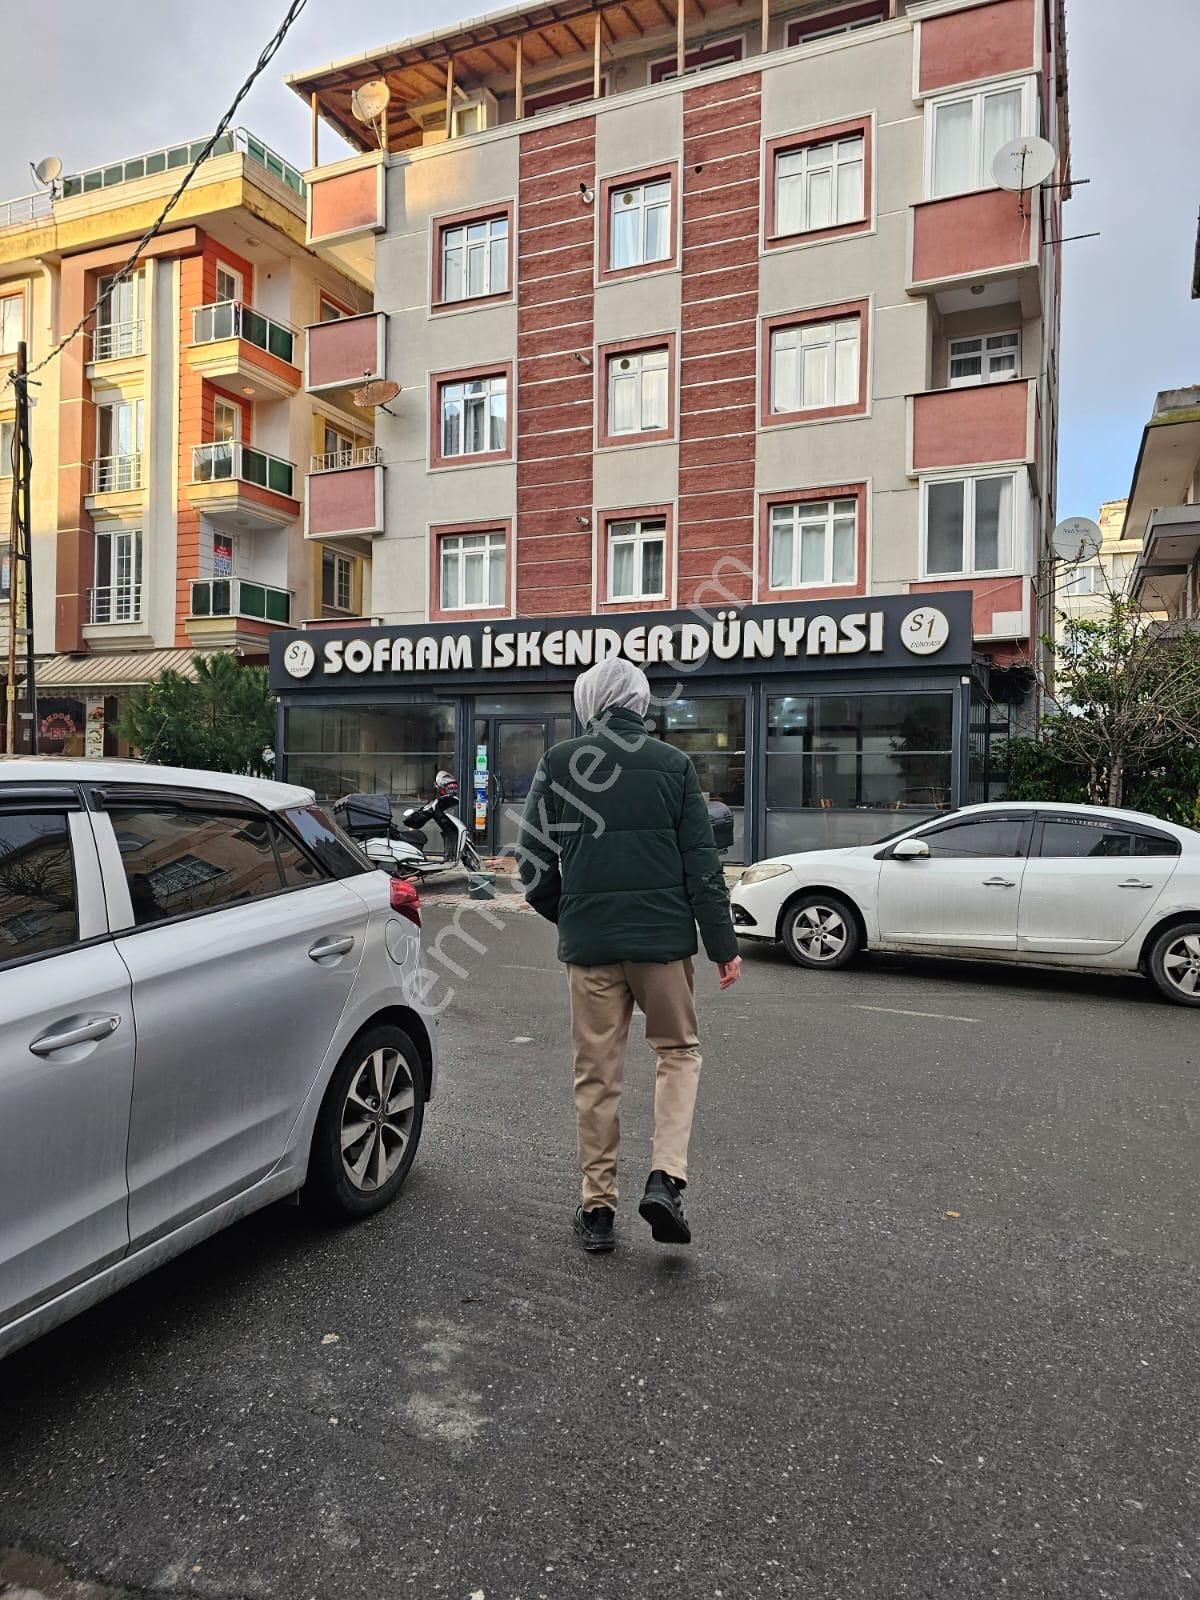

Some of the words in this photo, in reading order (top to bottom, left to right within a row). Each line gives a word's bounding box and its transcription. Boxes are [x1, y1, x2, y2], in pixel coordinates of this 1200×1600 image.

[323, 634, 473, 674] SOFRAM
[481, 624, 674, 669] İSKENDER
[681, 610, 885, 661] DÜNYASI
